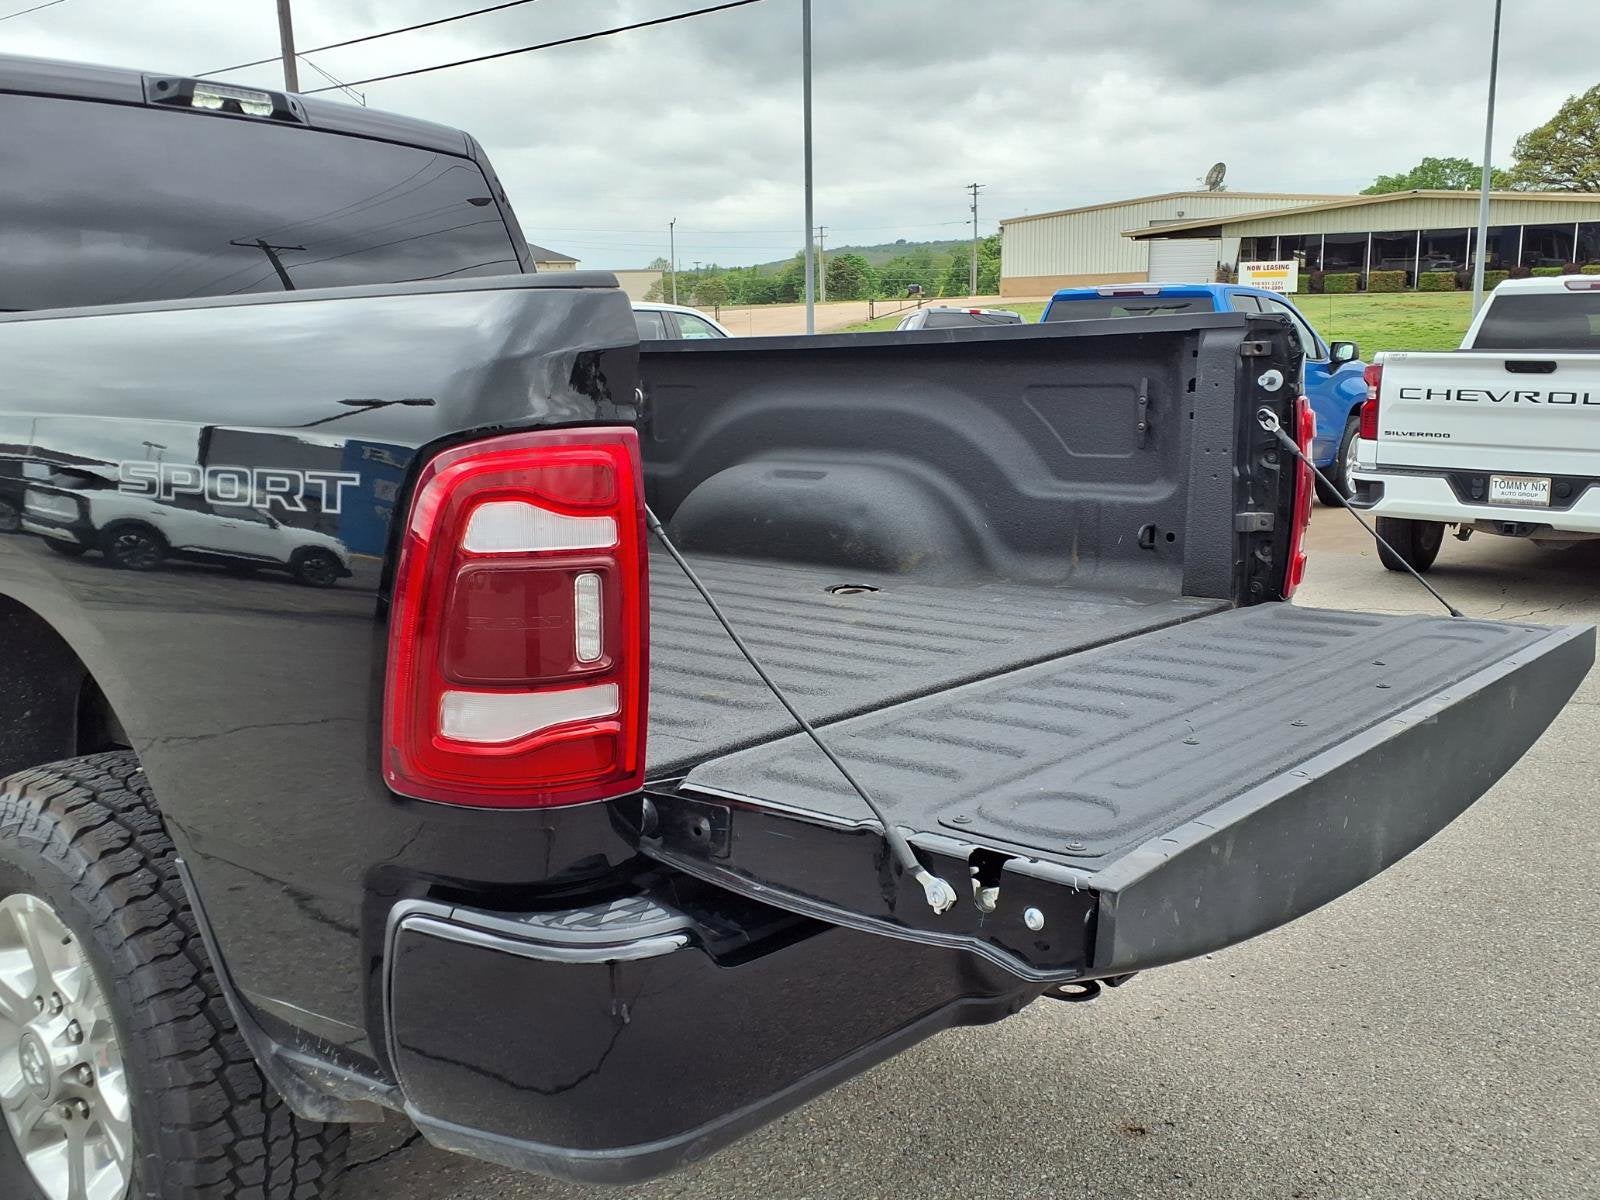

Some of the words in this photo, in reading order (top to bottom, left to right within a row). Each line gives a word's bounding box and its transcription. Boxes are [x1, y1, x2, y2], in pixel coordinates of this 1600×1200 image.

[1384, 430, 1451, 439] SILVERADO
[118, 459, 361, 514] SPORT
[1493, 480, 1529, 491] TOMMY
[1531, 483, 1548, 492] NIX
